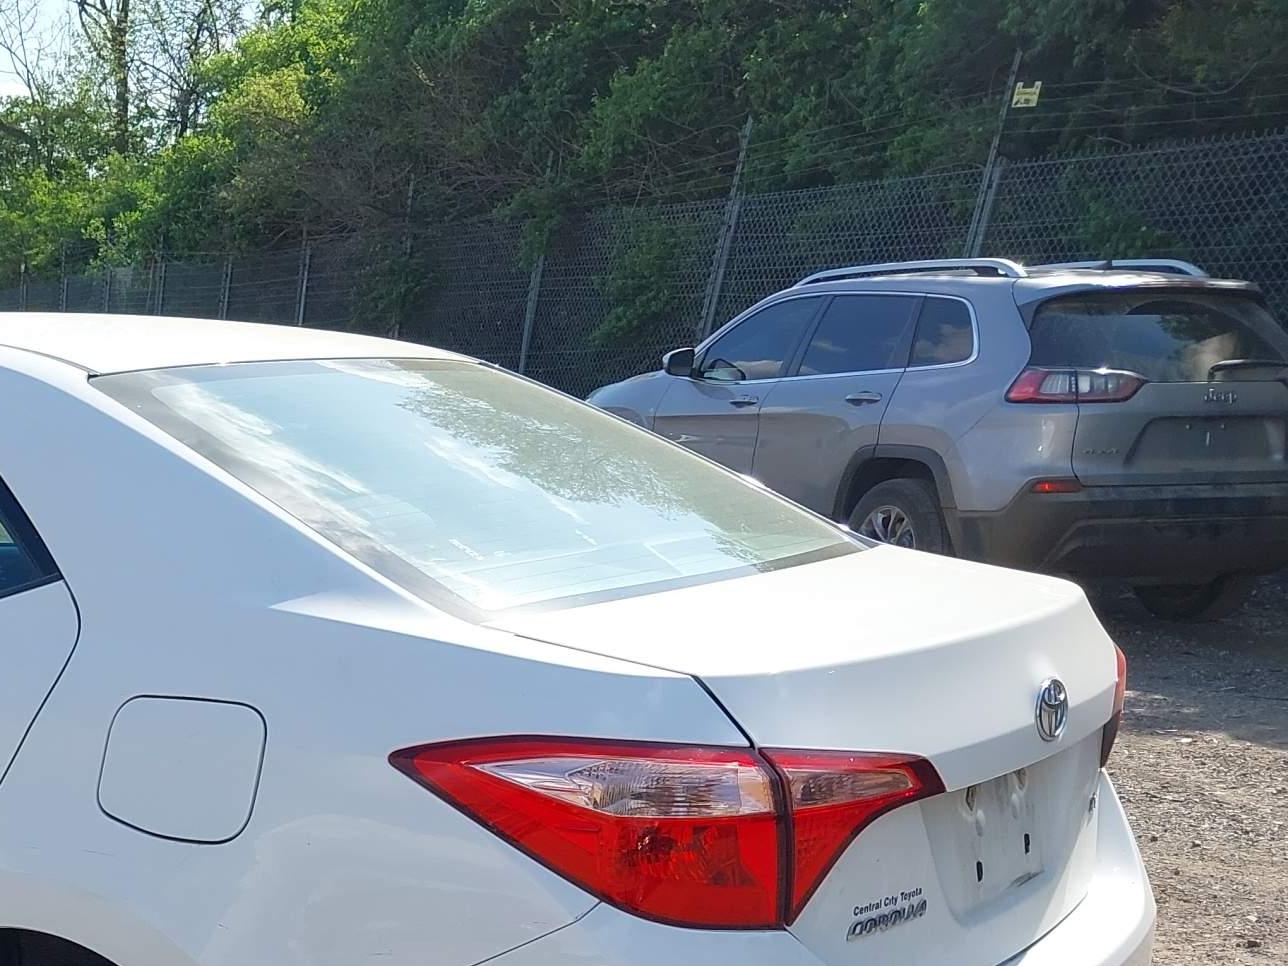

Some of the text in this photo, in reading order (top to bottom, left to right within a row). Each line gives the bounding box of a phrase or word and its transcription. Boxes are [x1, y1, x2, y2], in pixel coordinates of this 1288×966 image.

[1203, 388, 1238, 405] Jeep
[853, 887, 922, 916] Central City Toyota
[846, 899, 927, 941] COROLLA
